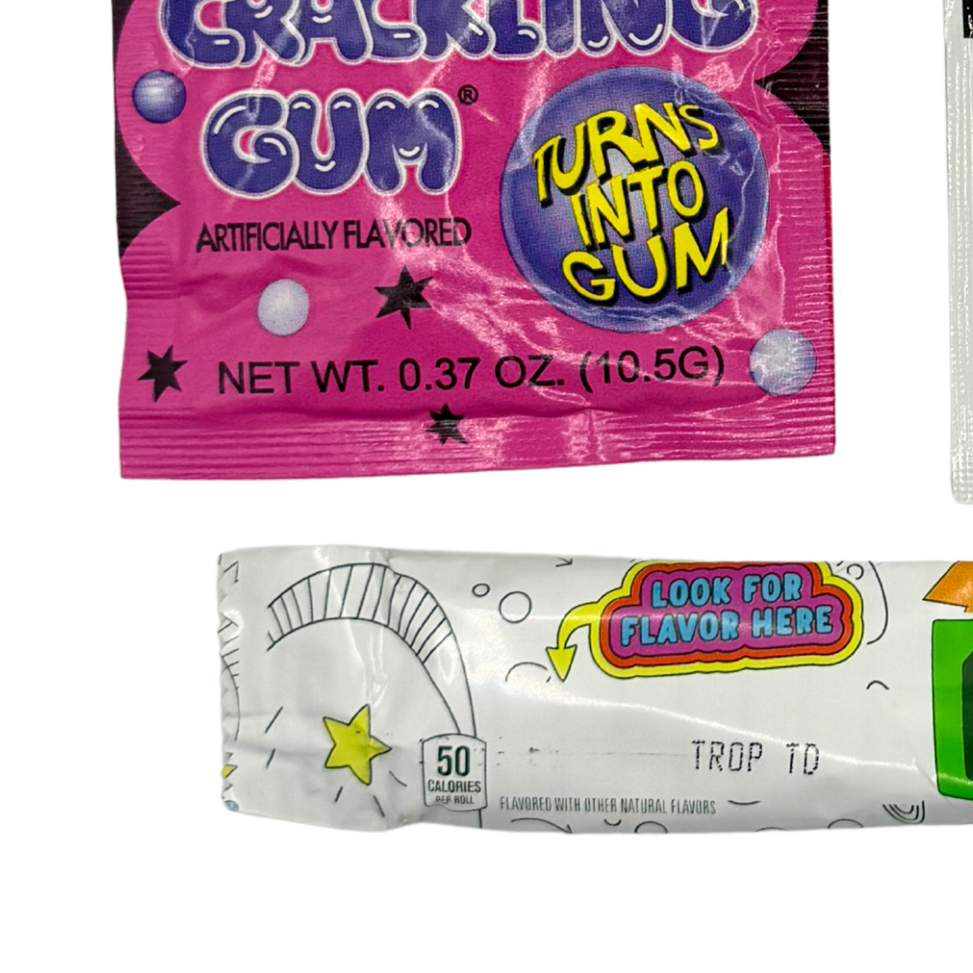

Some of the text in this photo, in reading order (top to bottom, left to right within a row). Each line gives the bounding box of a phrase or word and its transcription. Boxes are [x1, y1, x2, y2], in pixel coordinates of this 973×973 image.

[200, 88, 462, 200] GUM
[533, 102, 720, 204] TURNS
[571, 160, 705, 250] INTO
[196, 218, 472, 253] ARTIFICIALLY FLAVORED
[562, 210, 733, 304] GUM
[218, 346, 725, 395] NET WT. 0.37 OZ. (10.5G)
[652, 572, 802, 608] LOOK FOR
[620, 605, 832, 647] FLAVOR HERE
[437, 744, 471, 777] 50
[691, 740, 763, 772] TROP
[427, 780, 482, 794] CALORIES
[435, 794, 475, 805] PER ROLL
[500, 796, 716, 815] FLAVORED WITH OTHER NATURAL FLAVORS
